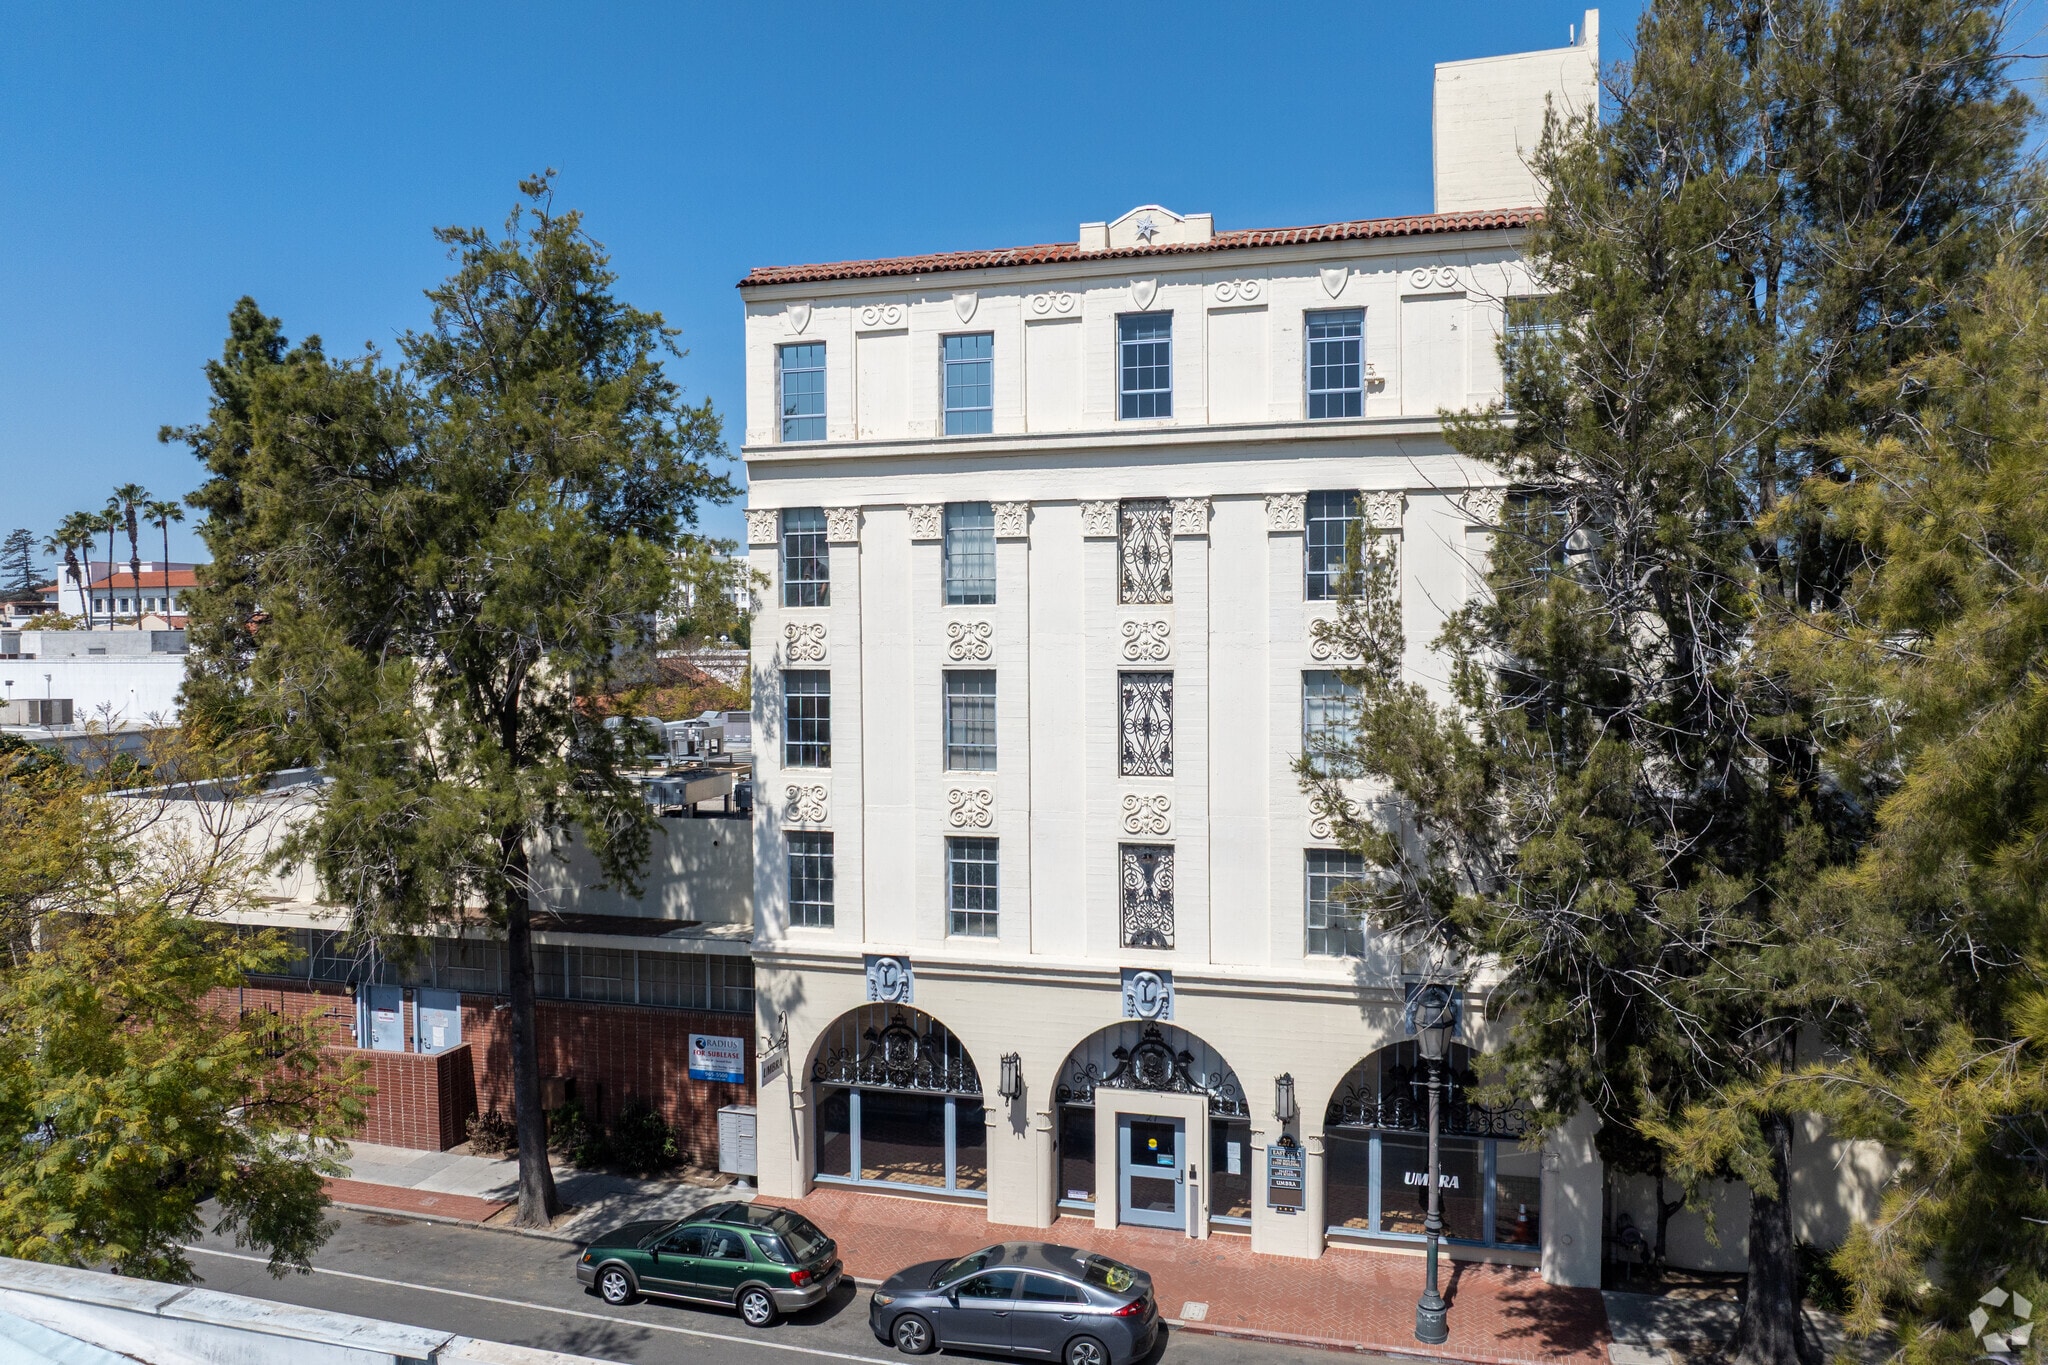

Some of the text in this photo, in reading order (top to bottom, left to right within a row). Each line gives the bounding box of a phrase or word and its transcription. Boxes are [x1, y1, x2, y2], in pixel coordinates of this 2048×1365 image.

[707, 1039, 737, 1048] RADIUS
[693, 1049, 739, 1059] FOR SUBLEASE
[1404, 1171, 1460, 1189] UMRA
